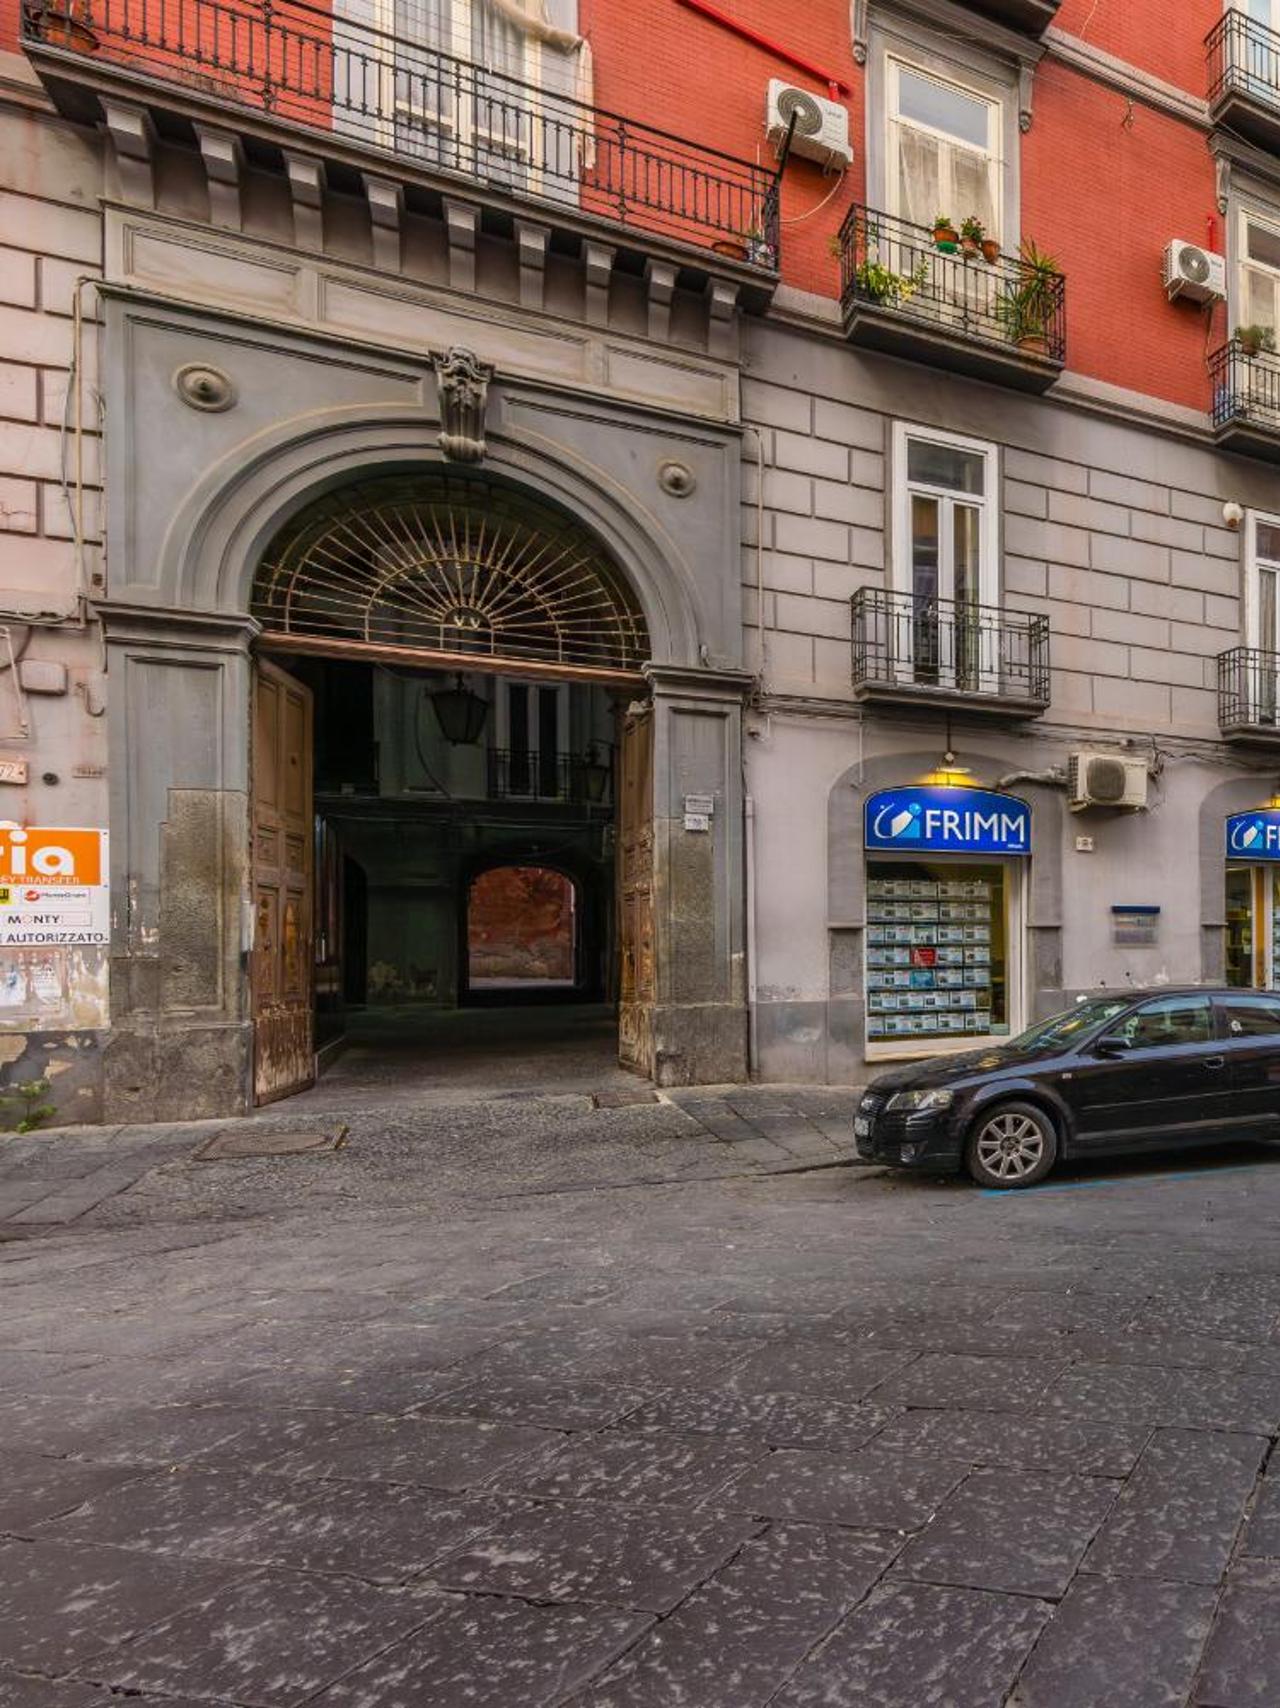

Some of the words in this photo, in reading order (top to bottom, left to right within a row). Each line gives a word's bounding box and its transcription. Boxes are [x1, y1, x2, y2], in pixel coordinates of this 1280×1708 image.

[925, 809, 1025, 843] FRIMM
[0, 830, 75, 876] ia
[7, 932, 103, 943] AUTORIZZATO
